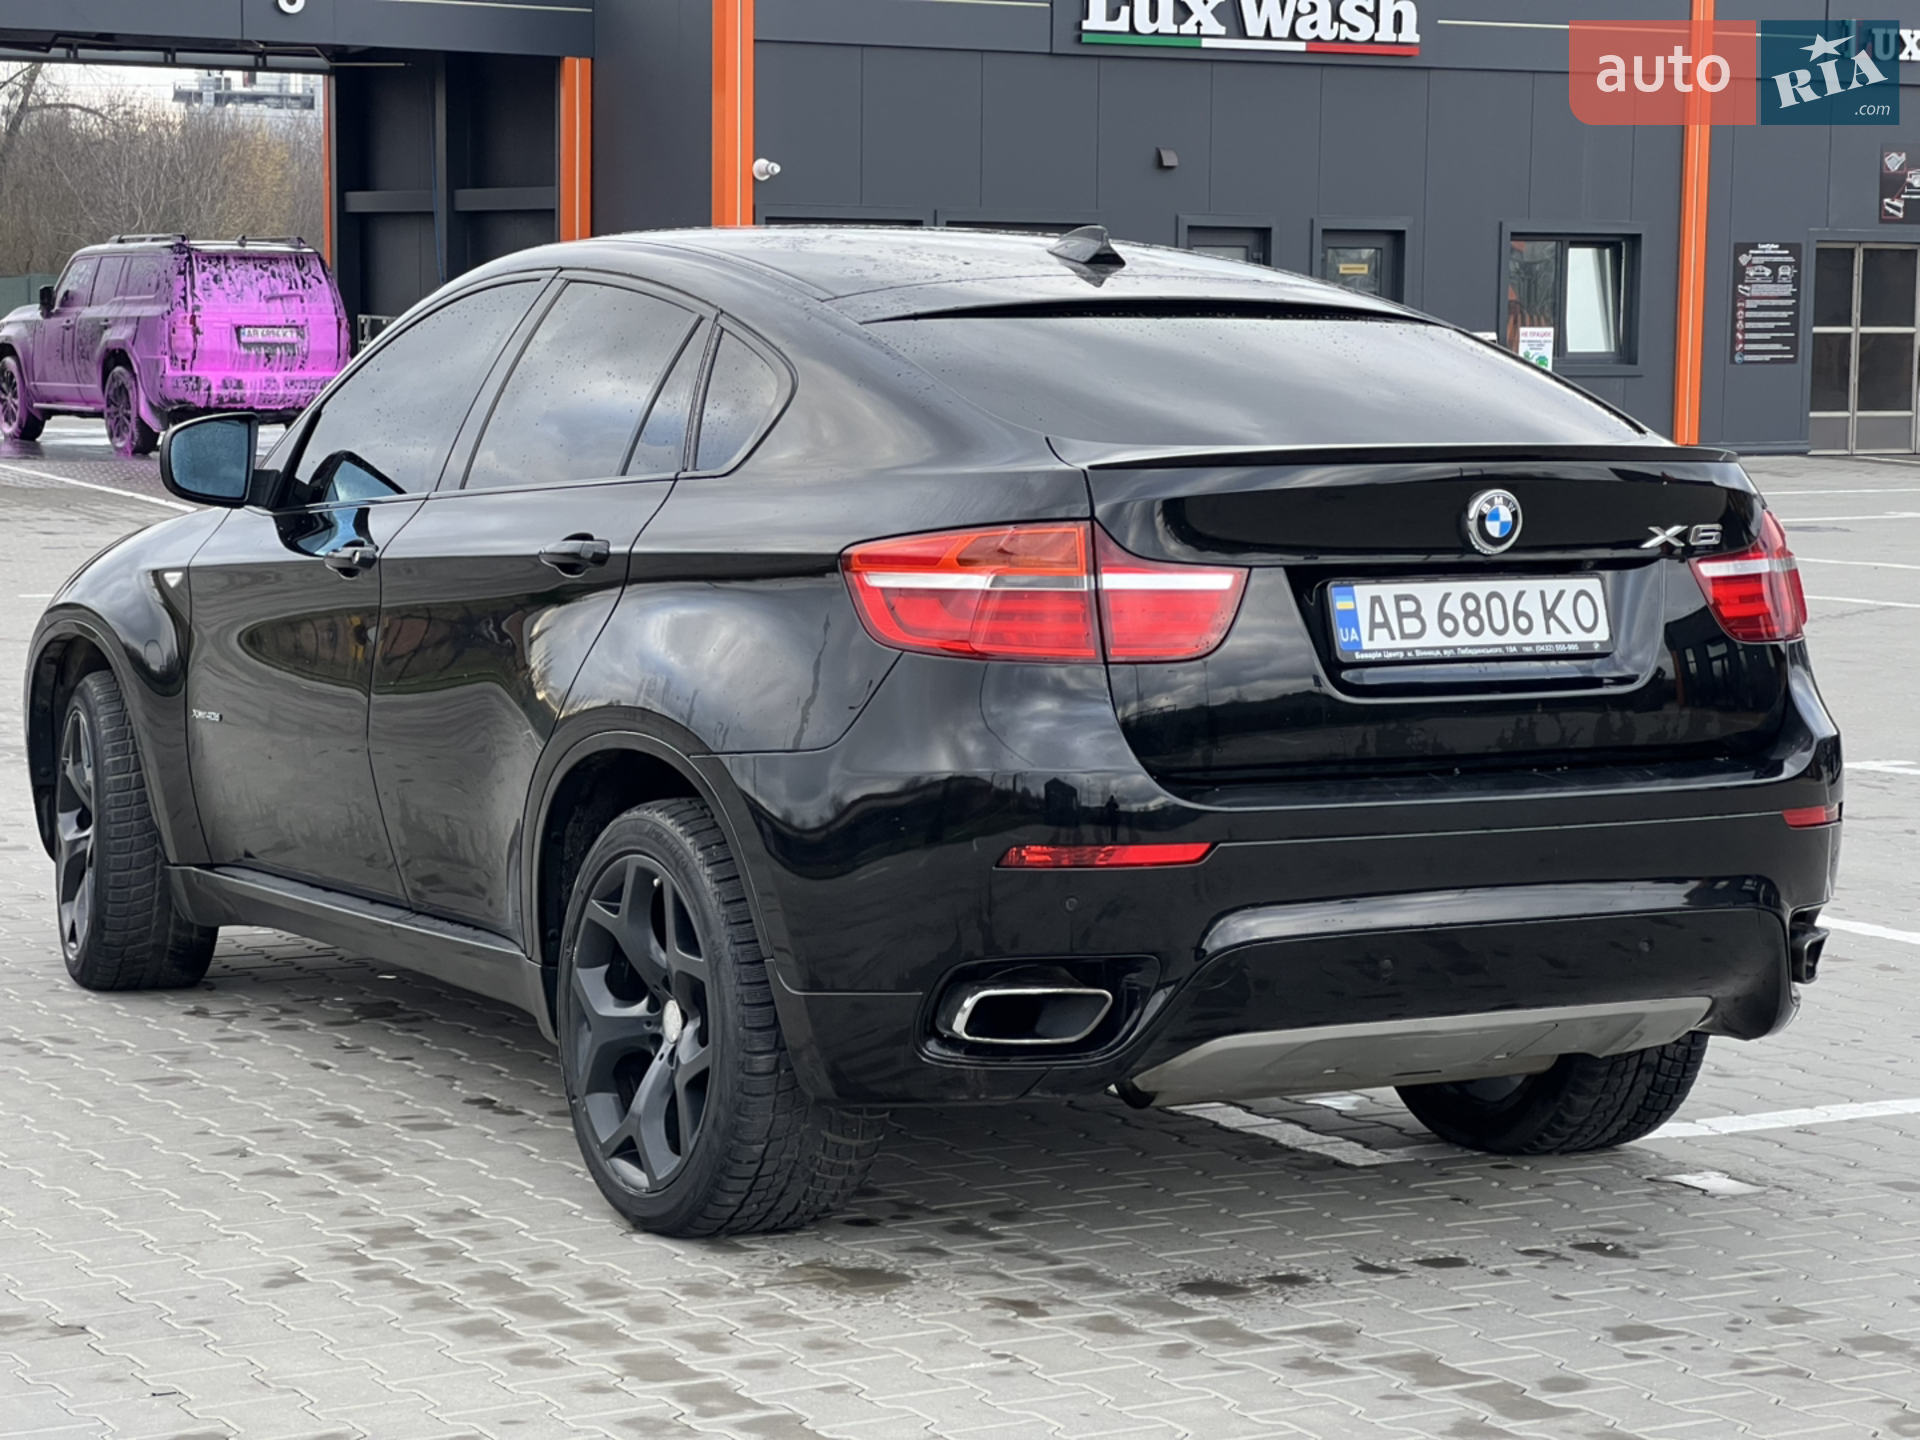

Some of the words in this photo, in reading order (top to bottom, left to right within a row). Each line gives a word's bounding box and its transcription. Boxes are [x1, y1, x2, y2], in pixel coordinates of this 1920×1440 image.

[1082, 0, 1226, 35] Lux
[1480, 496, 1517, 514] BMW
[1640, 523, 1723, 548] X6
[1368, 593, 1427, 642] AB
[1437, 590, 1534, 638] 6806
[1539, 588, 1600, 635] KO
[1339, 627, 1360, 642] UA
